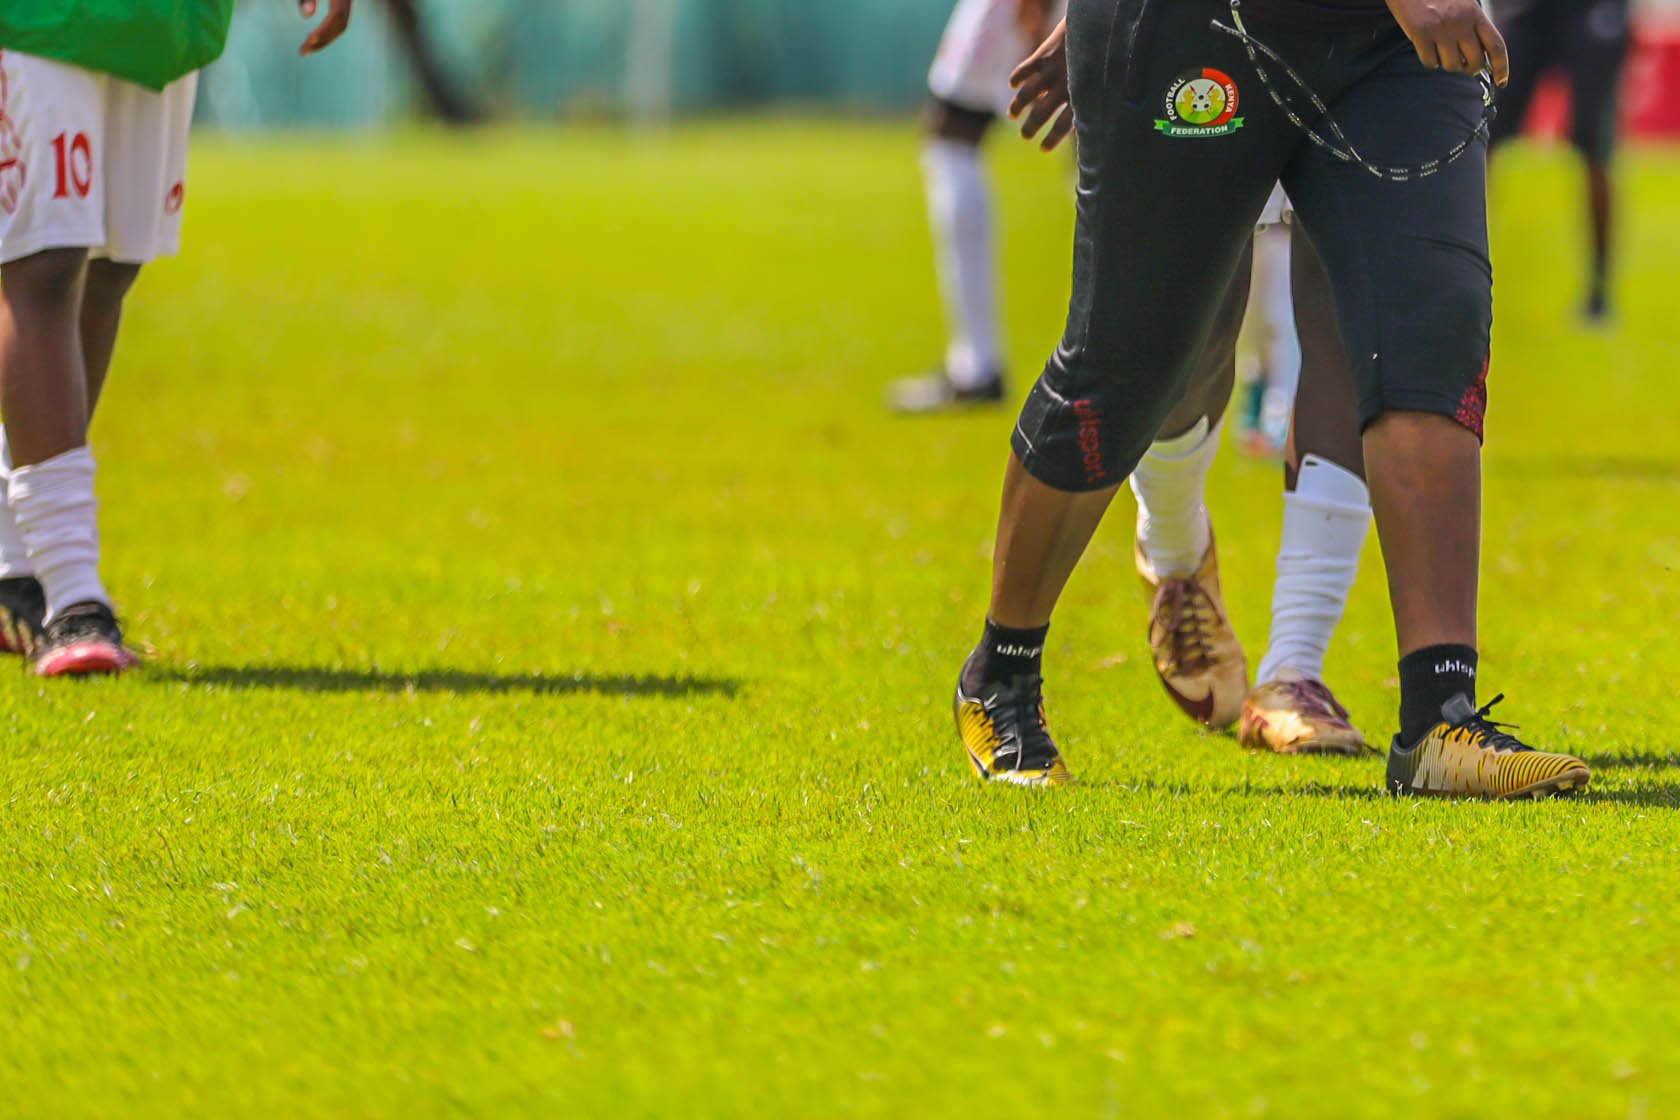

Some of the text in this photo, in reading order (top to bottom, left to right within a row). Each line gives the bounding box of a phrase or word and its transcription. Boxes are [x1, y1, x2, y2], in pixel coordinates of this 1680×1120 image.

[1165, 78, 1186, 121] FOOTBALL
[1225, 83, 1235, 113] KENYA
[1170, 125, 1229, 135] FEDERATION
[50, 132, 92, 198] 10
